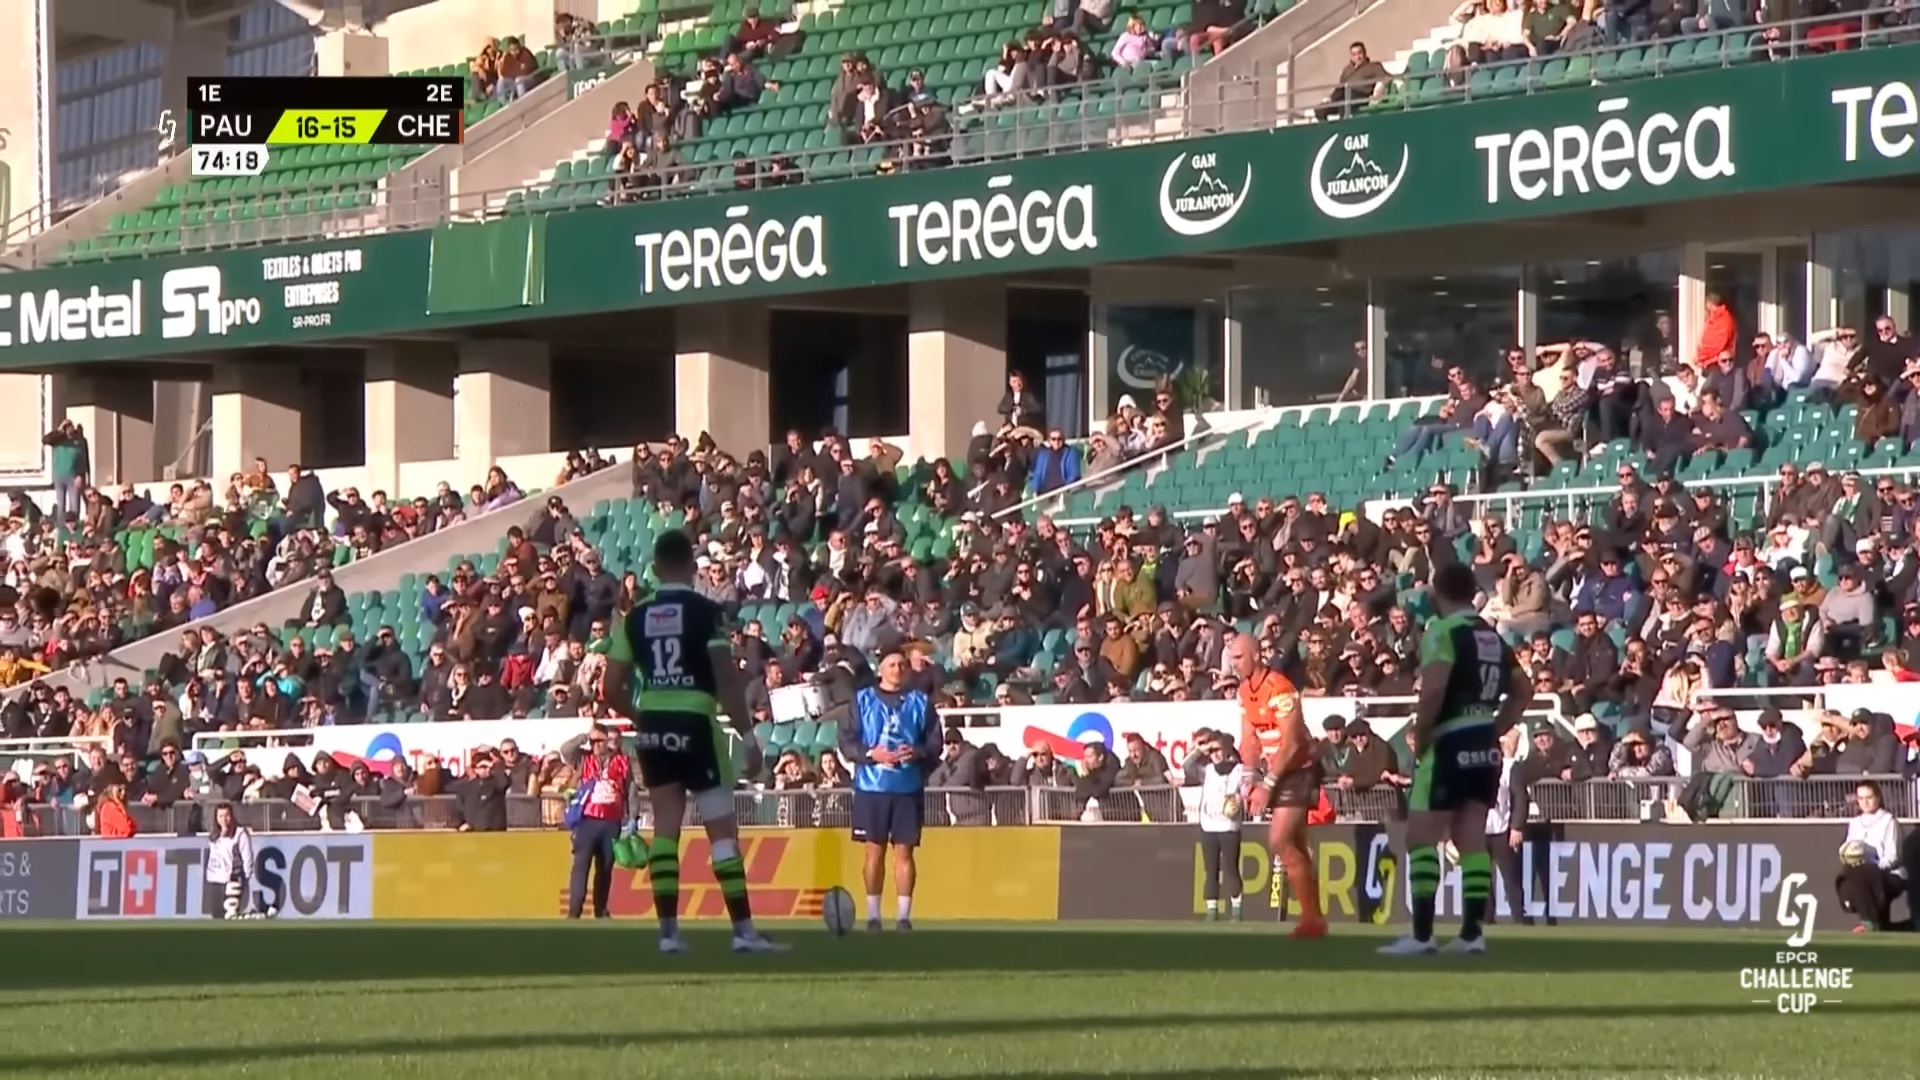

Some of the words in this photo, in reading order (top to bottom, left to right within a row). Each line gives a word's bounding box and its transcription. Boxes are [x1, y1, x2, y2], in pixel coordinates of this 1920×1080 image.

[1344, 133, 1369, 151] GAN
[1191, 153, 1217, 170] GAN
[1326, 174, 1389, 196] JURANÇON
[1174, 193, 1234, 213] JURANÇON
[262, 255, 301, 280] TEXTILES
[302, 256, 310, 275] &
[20, 278, 142, 345] Metal
[651, 637, 683, 677] 12
[19, 852, 31, 877] &
[165, 846, 364, 919] TSOT
[1682, 843, 1782, 922] CUP
